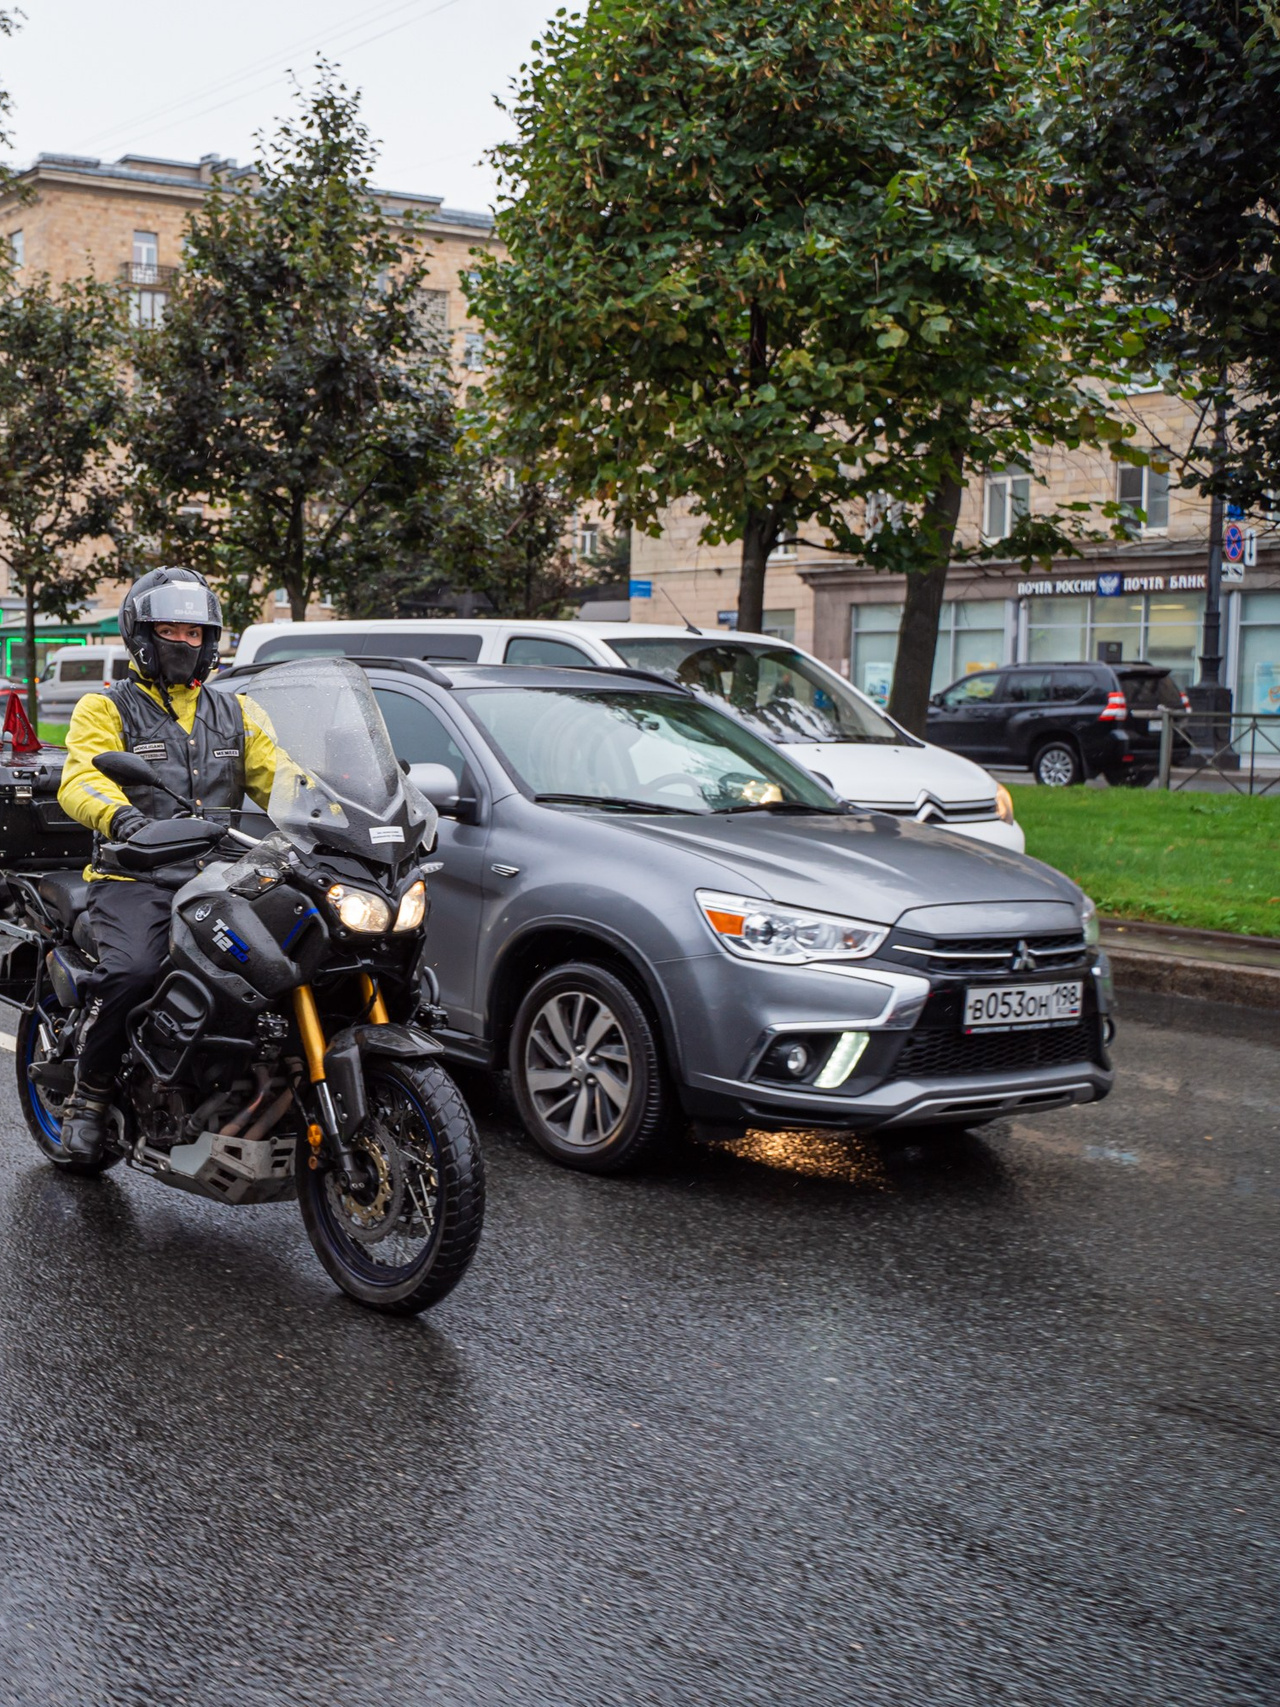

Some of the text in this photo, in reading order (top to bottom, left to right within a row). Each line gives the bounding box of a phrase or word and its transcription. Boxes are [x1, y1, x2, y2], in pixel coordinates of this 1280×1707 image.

[1017, 574, 1206, 595] ПОЧТА РОССИИ ПОЧТА БАНК
[1051, 985, 1080, 1006] 198
